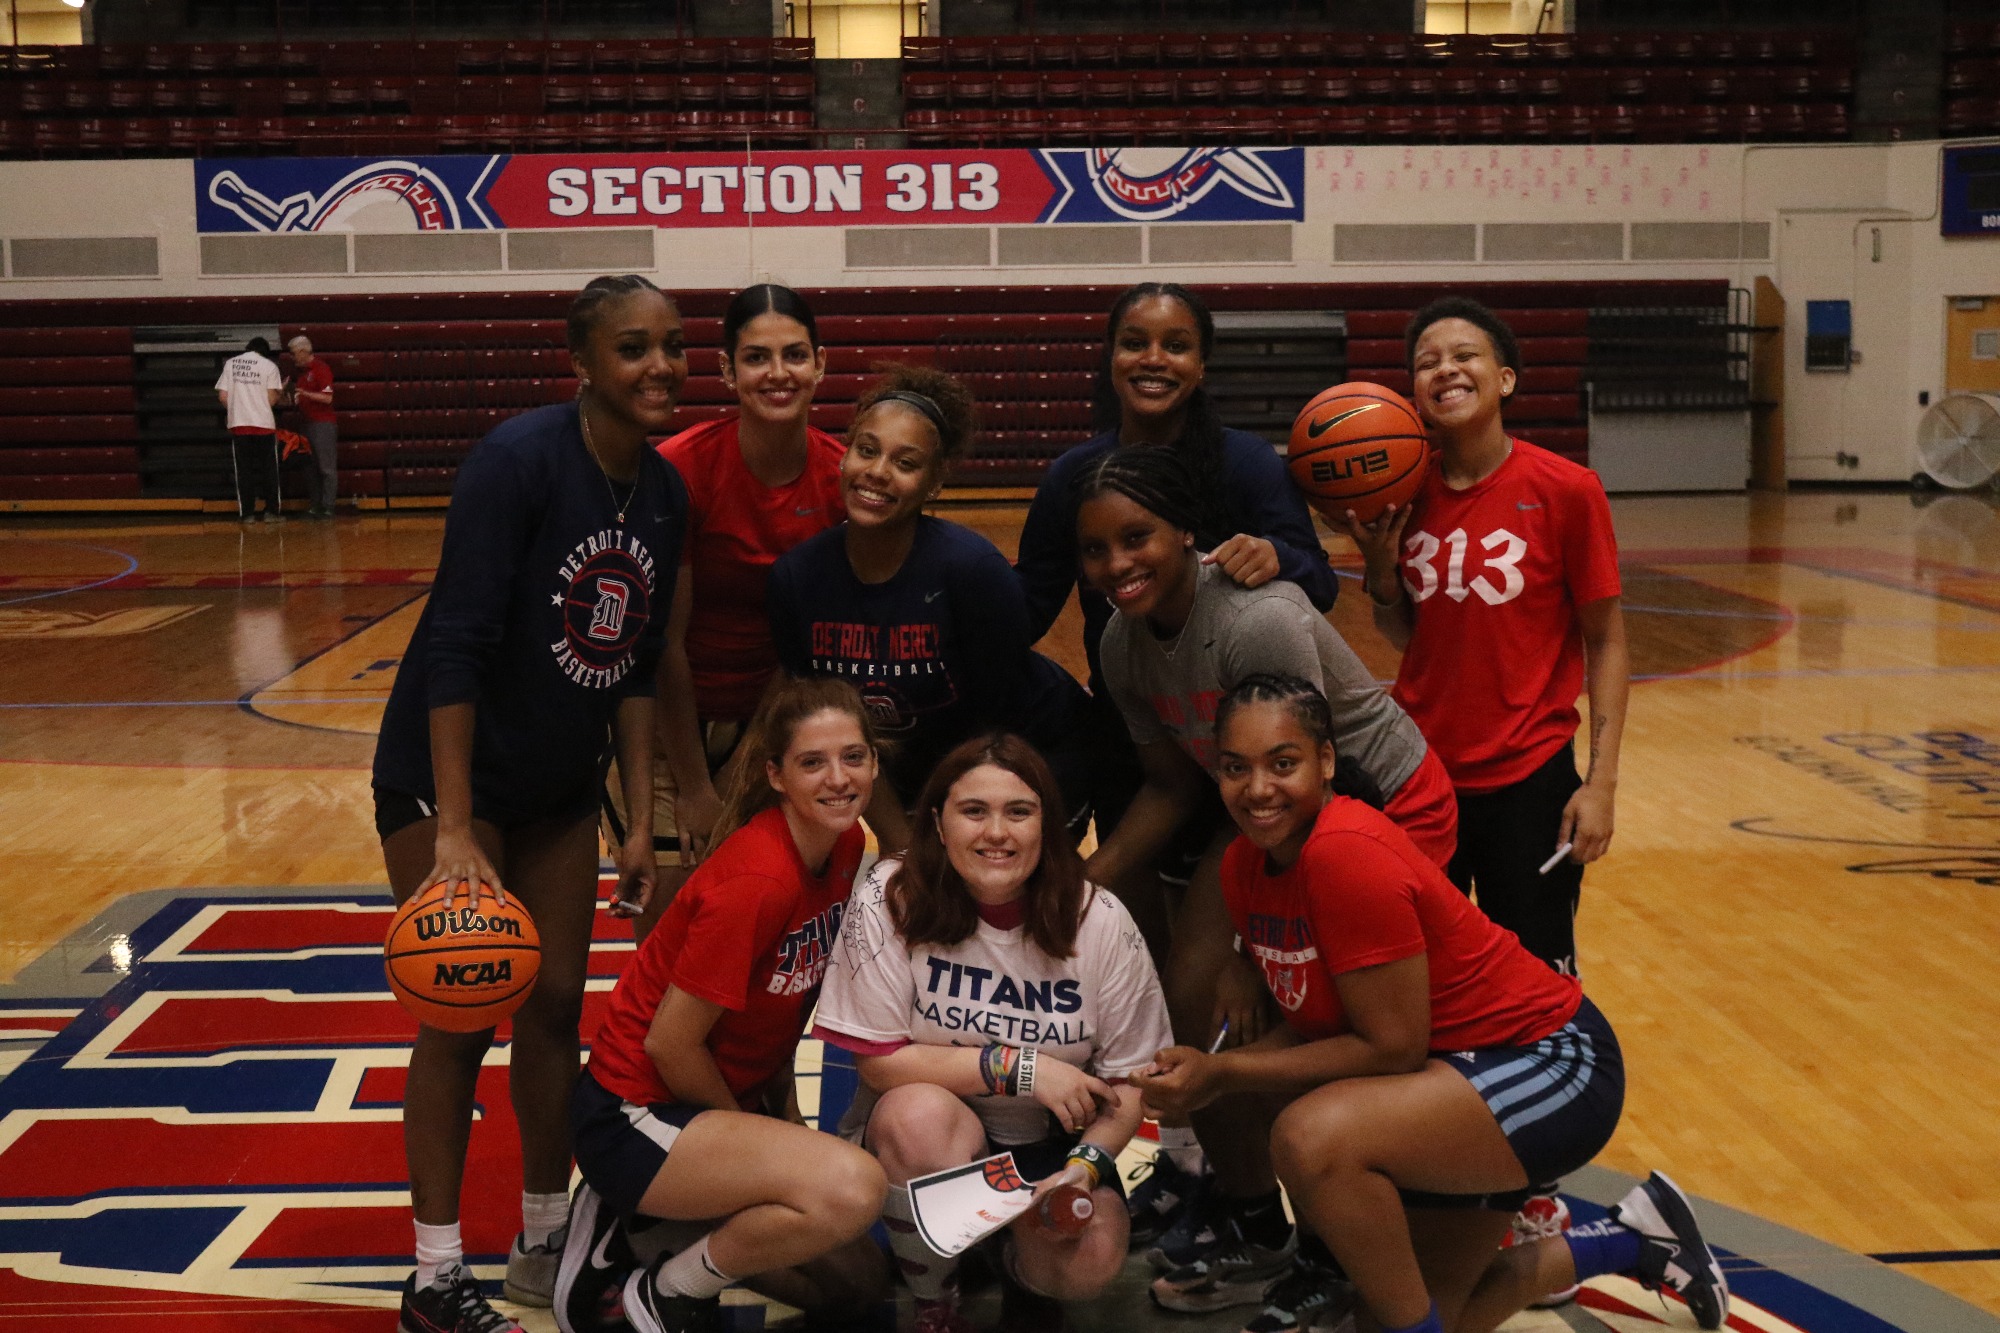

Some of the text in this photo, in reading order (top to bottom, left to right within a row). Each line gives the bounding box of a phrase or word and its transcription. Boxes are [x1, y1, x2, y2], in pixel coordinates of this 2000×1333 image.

[853, 98, 865, 113] C
[547, 162, 1000, 217] SECTION 313
[1311, 449, 1390, 483] ELITE
[558, 529, 623, 583] DETROIT
[1403, 527, 1528, 606] 313
[811, 621, 881, 661] DETROIT
[551, 637, 636, 690] BASKETBALL
[812, 659, 946, 676] BASKETBALL
[414, 907, 522, 941] Wilson
[433, 958, 512, 987] NCAA
[926, 955, 1083, 1014] TITANS
[914, 998, 1090, 1046] ASKETBALL
[1019, 1064, 1034, 1092] STATE
